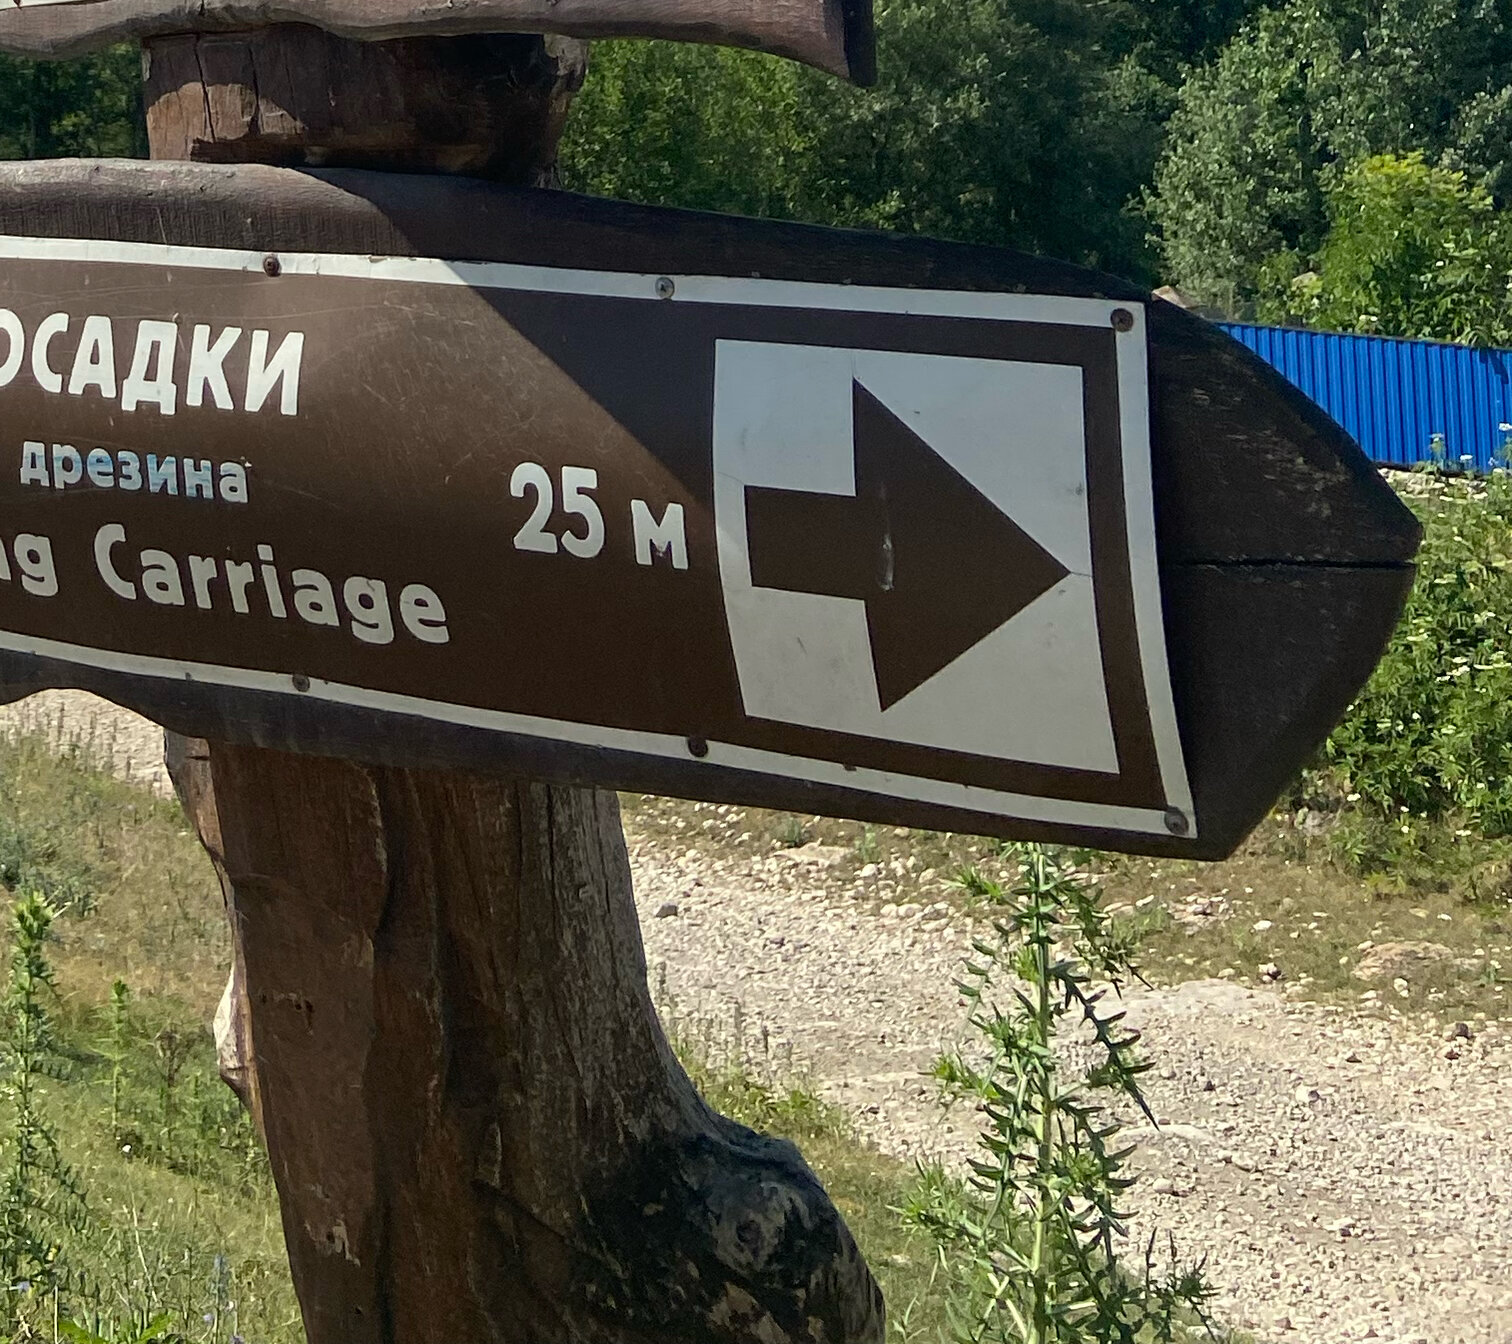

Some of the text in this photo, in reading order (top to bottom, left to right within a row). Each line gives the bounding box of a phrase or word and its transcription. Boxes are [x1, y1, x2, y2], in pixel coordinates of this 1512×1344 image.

[18, 440, 251, 503] дрезина
[510, 462, 604, 560] 25
[93, 524, 450, 645] Carriage
